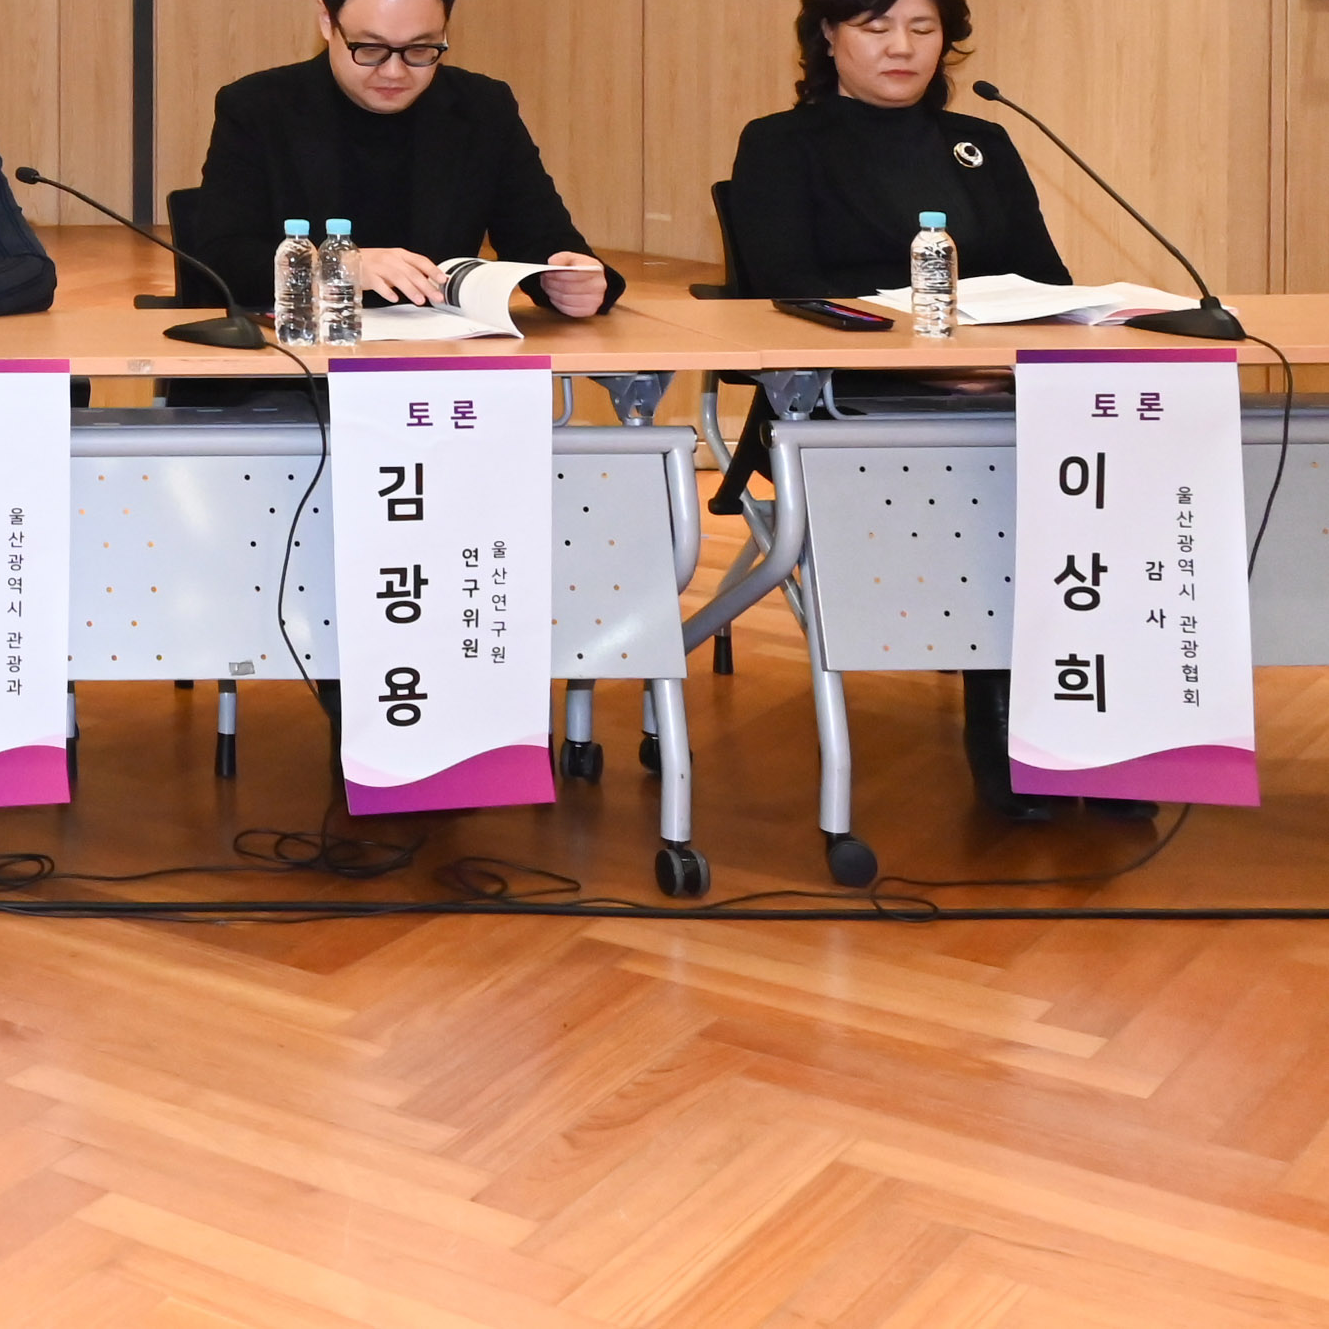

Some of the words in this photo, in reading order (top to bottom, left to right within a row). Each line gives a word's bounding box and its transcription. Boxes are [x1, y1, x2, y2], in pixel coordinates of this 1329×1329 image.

[405, 399, 478, 430] 토론
[1090, 391, 1165, 422] 토론
[6, 507, 26, 619] 울산광역시
[375, 462, 429, 728] 김광용
[1053, 451, 1109, 713] 이상희
[1145, 560, 1167, 630] 감사
[1175, 485, 1195, 602] 울산광역시
[461, 546, 480, 659] 연구위원
[490, 540, 508, 664] 울산연구원
[5, 630, 23, 697] 관광과
[1178, 615, 1200, 708] 관광협회
